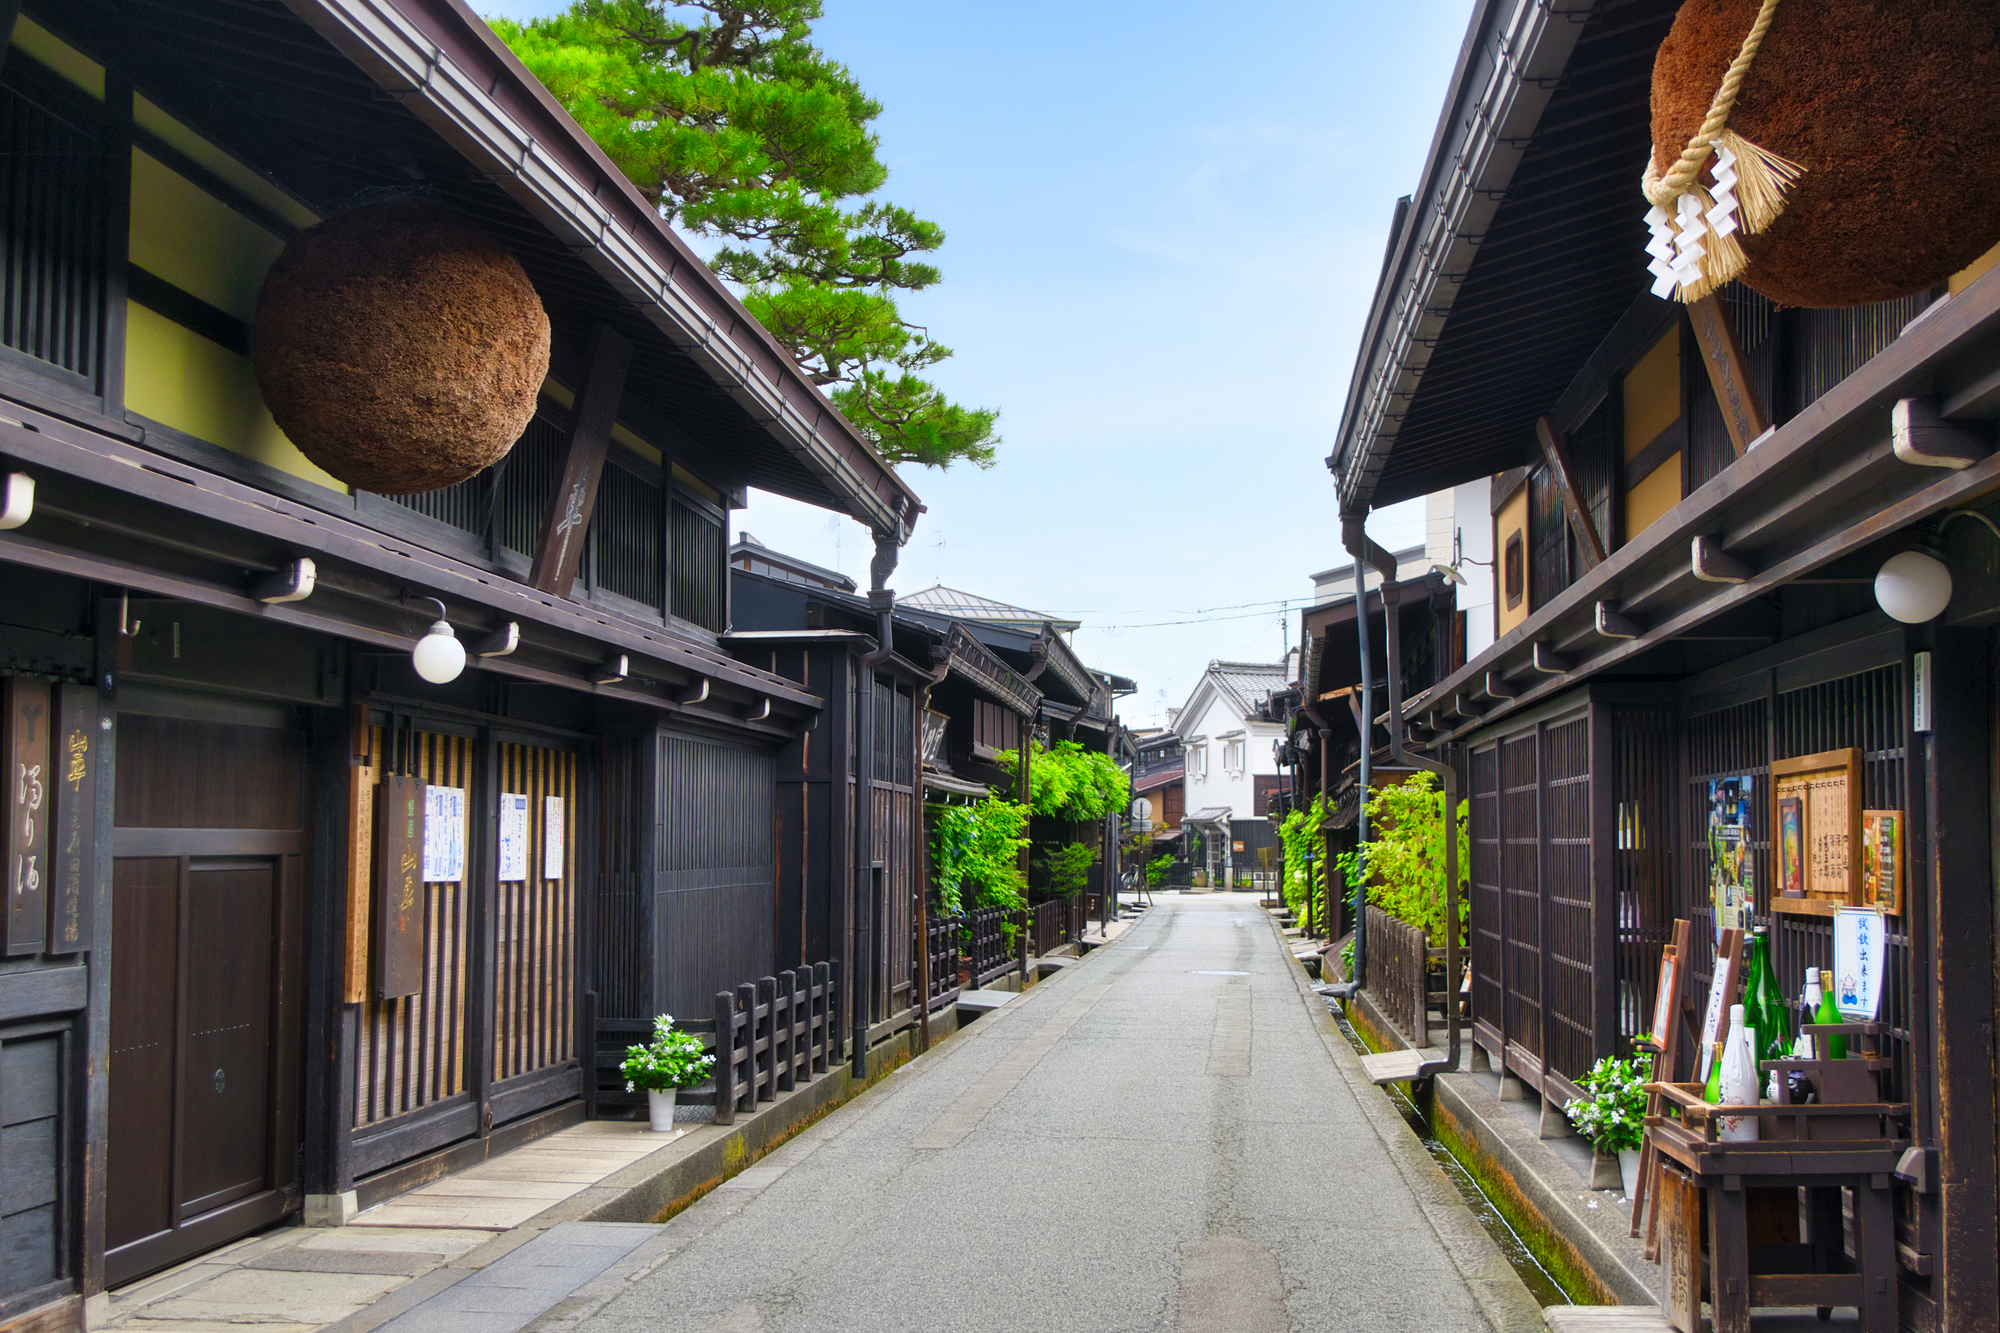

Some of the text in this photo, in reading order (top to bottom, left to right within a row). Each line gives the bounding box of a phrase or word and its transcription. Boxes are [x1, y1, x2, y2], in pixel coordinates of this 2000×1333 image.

[1857, 917, 1869, 1008] 試飲出来ます
